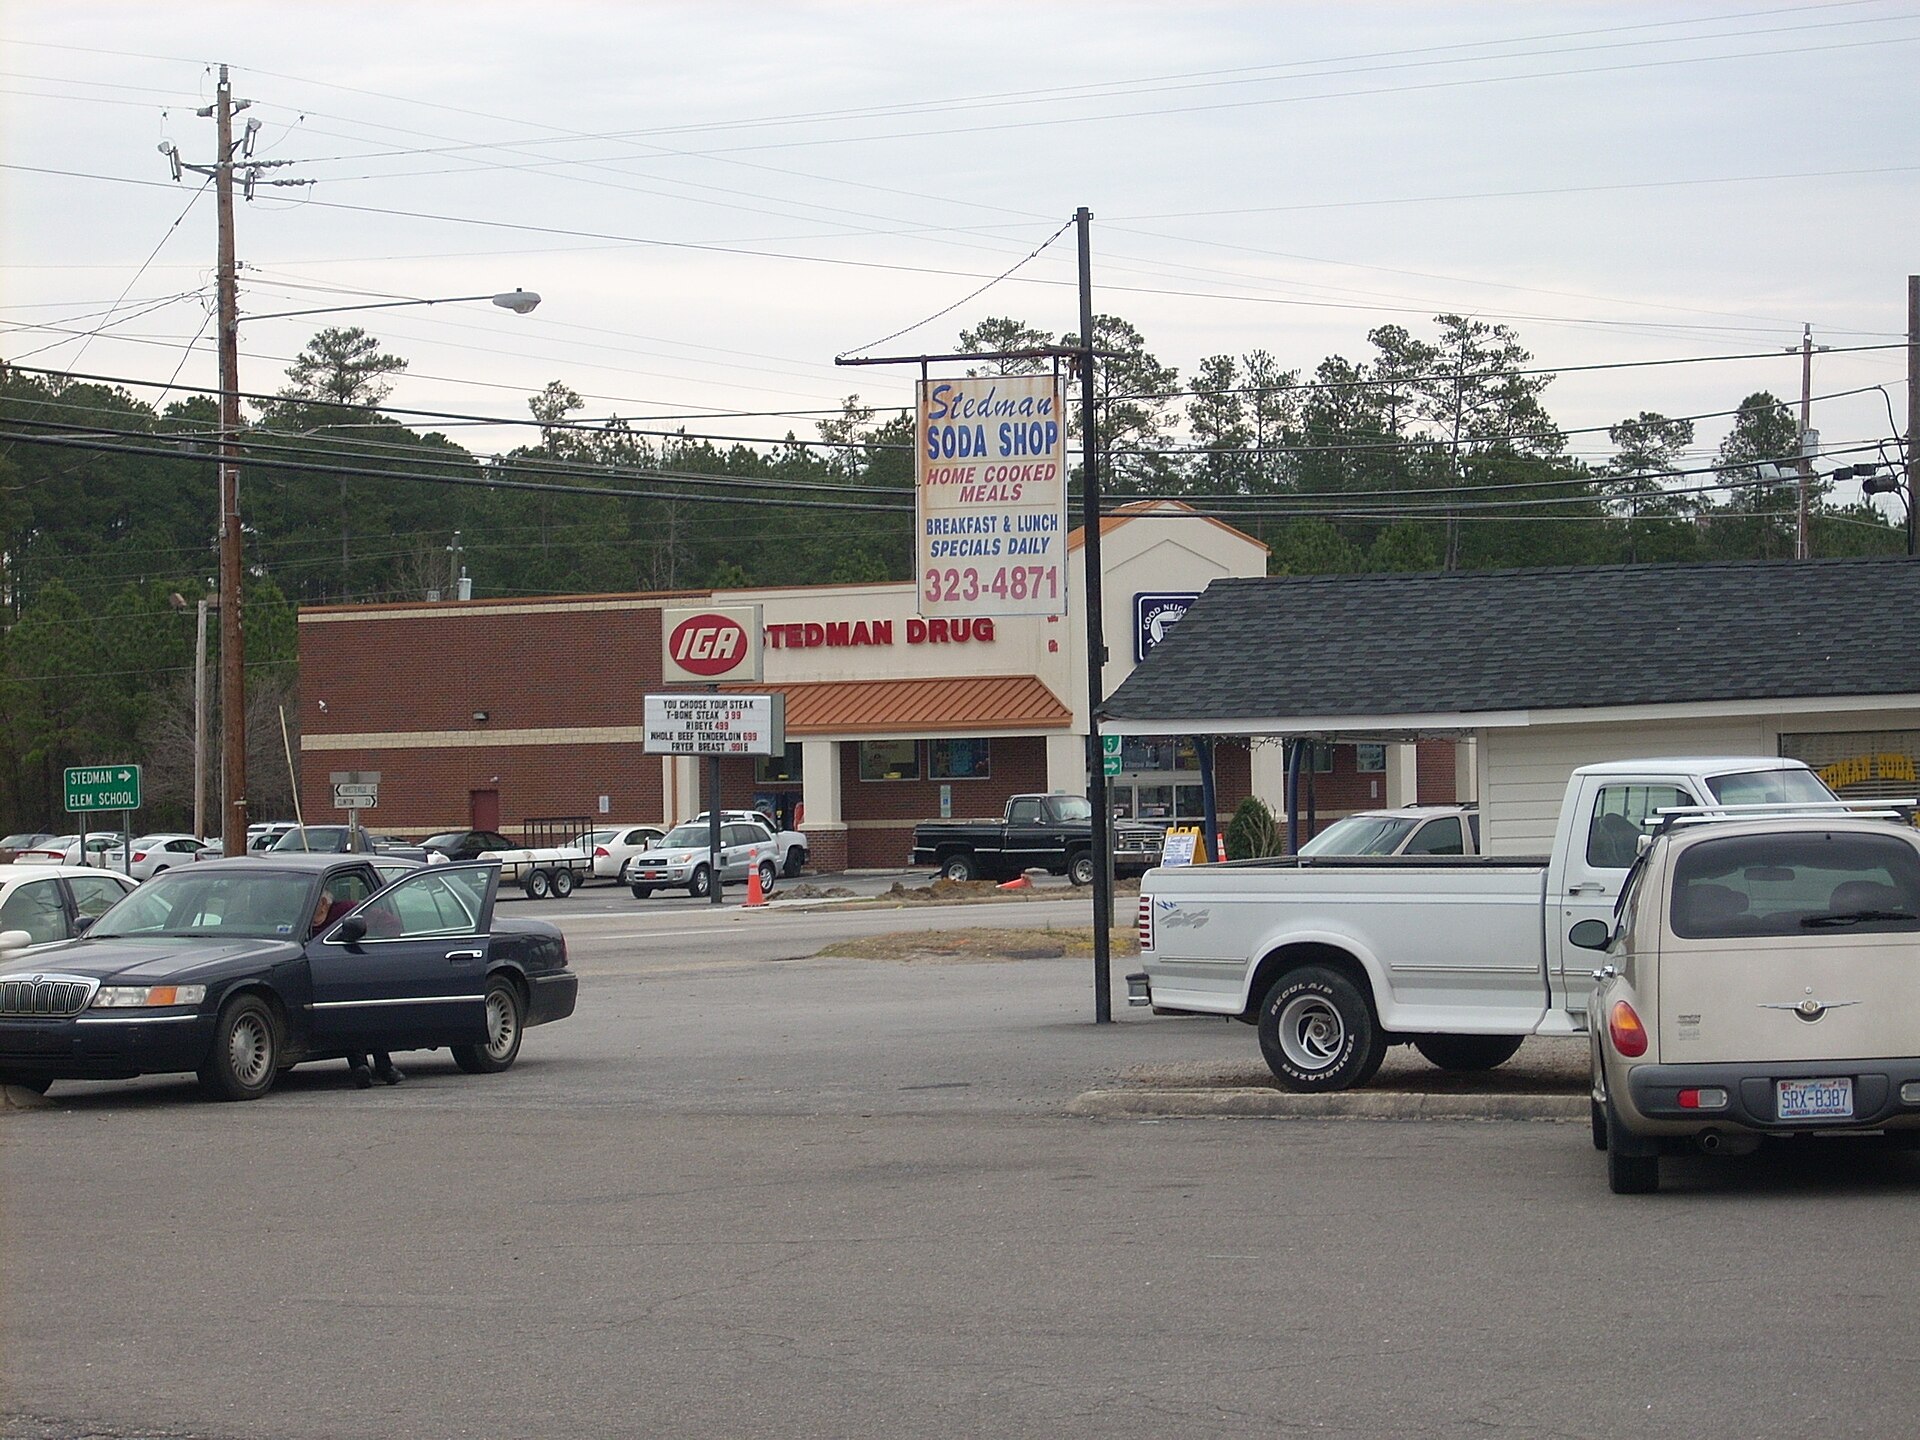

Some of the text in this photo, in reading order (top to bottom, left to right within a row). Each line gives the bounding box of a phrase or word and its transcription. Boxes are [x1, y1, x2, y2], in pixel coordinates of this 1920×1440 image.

[928, 384, 1053, 420] Stedman
[927, 420, 1058, 460] SODA SHOP
[926, 463, 1057, 485] HOME COOKED
[959, 483, 1023, 503] MEALS
[926, 514, 1058, 535] BREAKFAST & LUNCH
[930, 537, 1051, 558] SPECIALS DAILY
[925, 565, 1057, 602] 323-4871
[1143, 607, 1161, 630] GOOD
[906, 618, 996, 644] DRUG
[676, 627, 740, 660] IGA
[663, 700, 754, 709] YOU CHOOSE YOUR STEAK
[666, 711, 693, 720] T-BONE
[696, 711, 719, 720] STEAK
[686, 721, 729, 730] RIBEYE 499
[650, 732, 758, 741] WHOLE BEEF TENDERLOIN 699
[671, 742, 694, 751] FRYER
[698, 742, 725, 751] BREAST
[1107, 738, 1113, 751] 5
[70, 771, 112, 785] STEDMAN
[98, 792, 134, 805] SCHOOL
